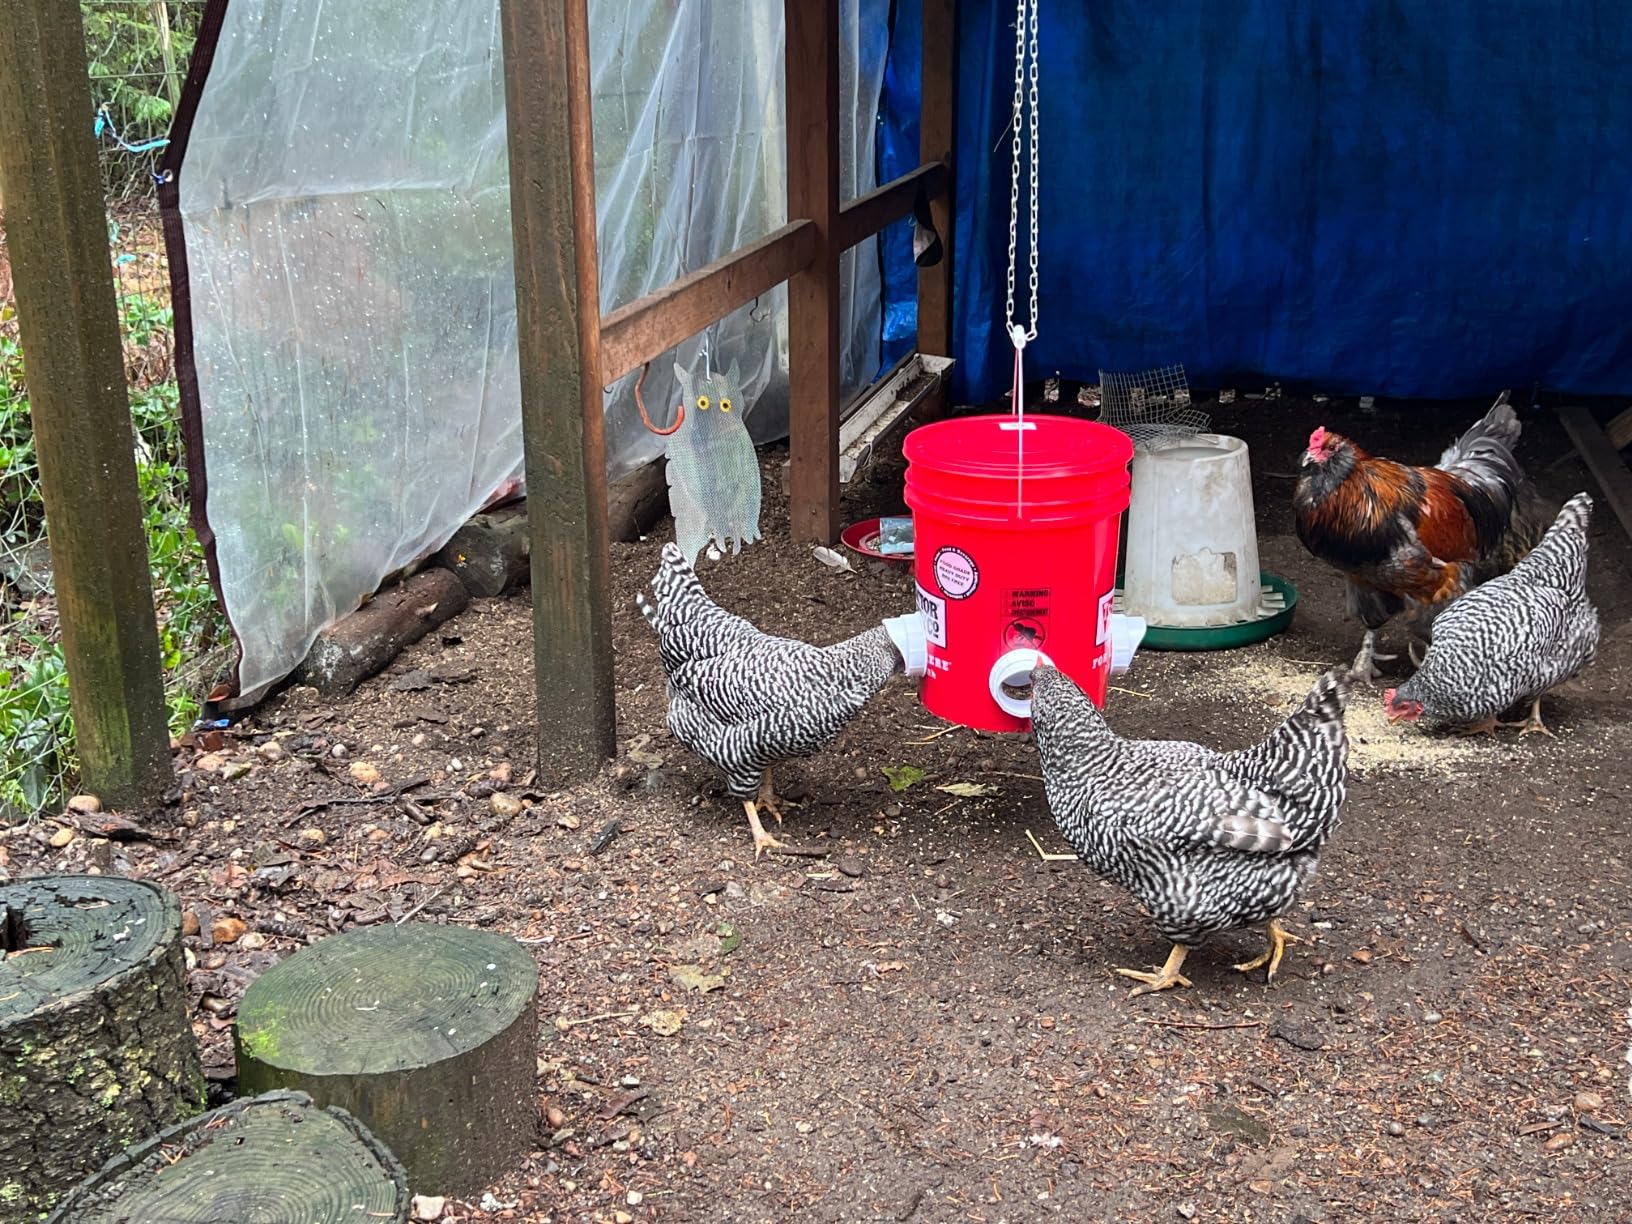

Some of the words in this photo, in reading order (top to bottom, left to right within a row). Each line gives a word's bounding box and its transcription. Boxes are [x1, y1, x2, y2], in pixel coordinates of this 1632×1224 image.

[939, 566, 954, 575] HEAVY
[955, 573, 969, 582] DUTY
[953, 566, 970, 575] GRADE
